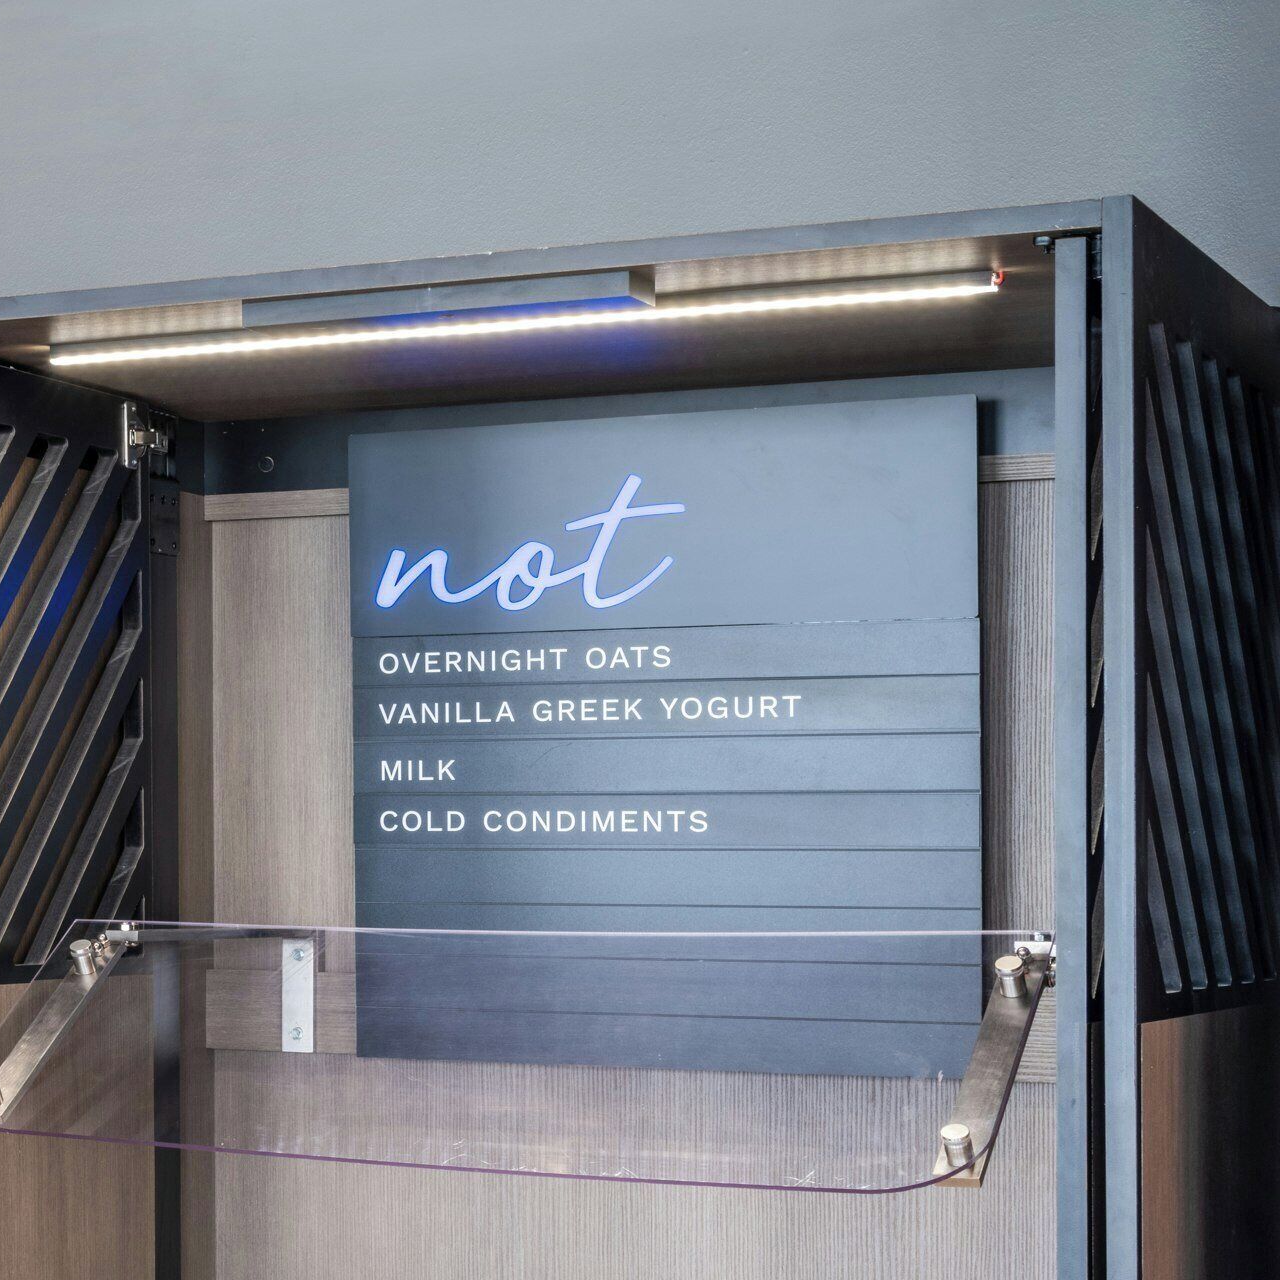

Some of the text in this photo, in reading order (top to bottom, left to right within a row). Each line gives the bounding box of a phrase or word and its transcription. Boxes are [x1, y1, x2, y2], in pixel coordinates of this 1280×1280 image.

[376, 474, 686, 611] not
[378, 645, 672, 675] OVERNIGHT OATS
[378, 694, 802, 725] VANILLA GREEK YOGURT
[381, 759, 456, 781] MILK
[379, 809, 709, 833] COLD CONDIMENTS
